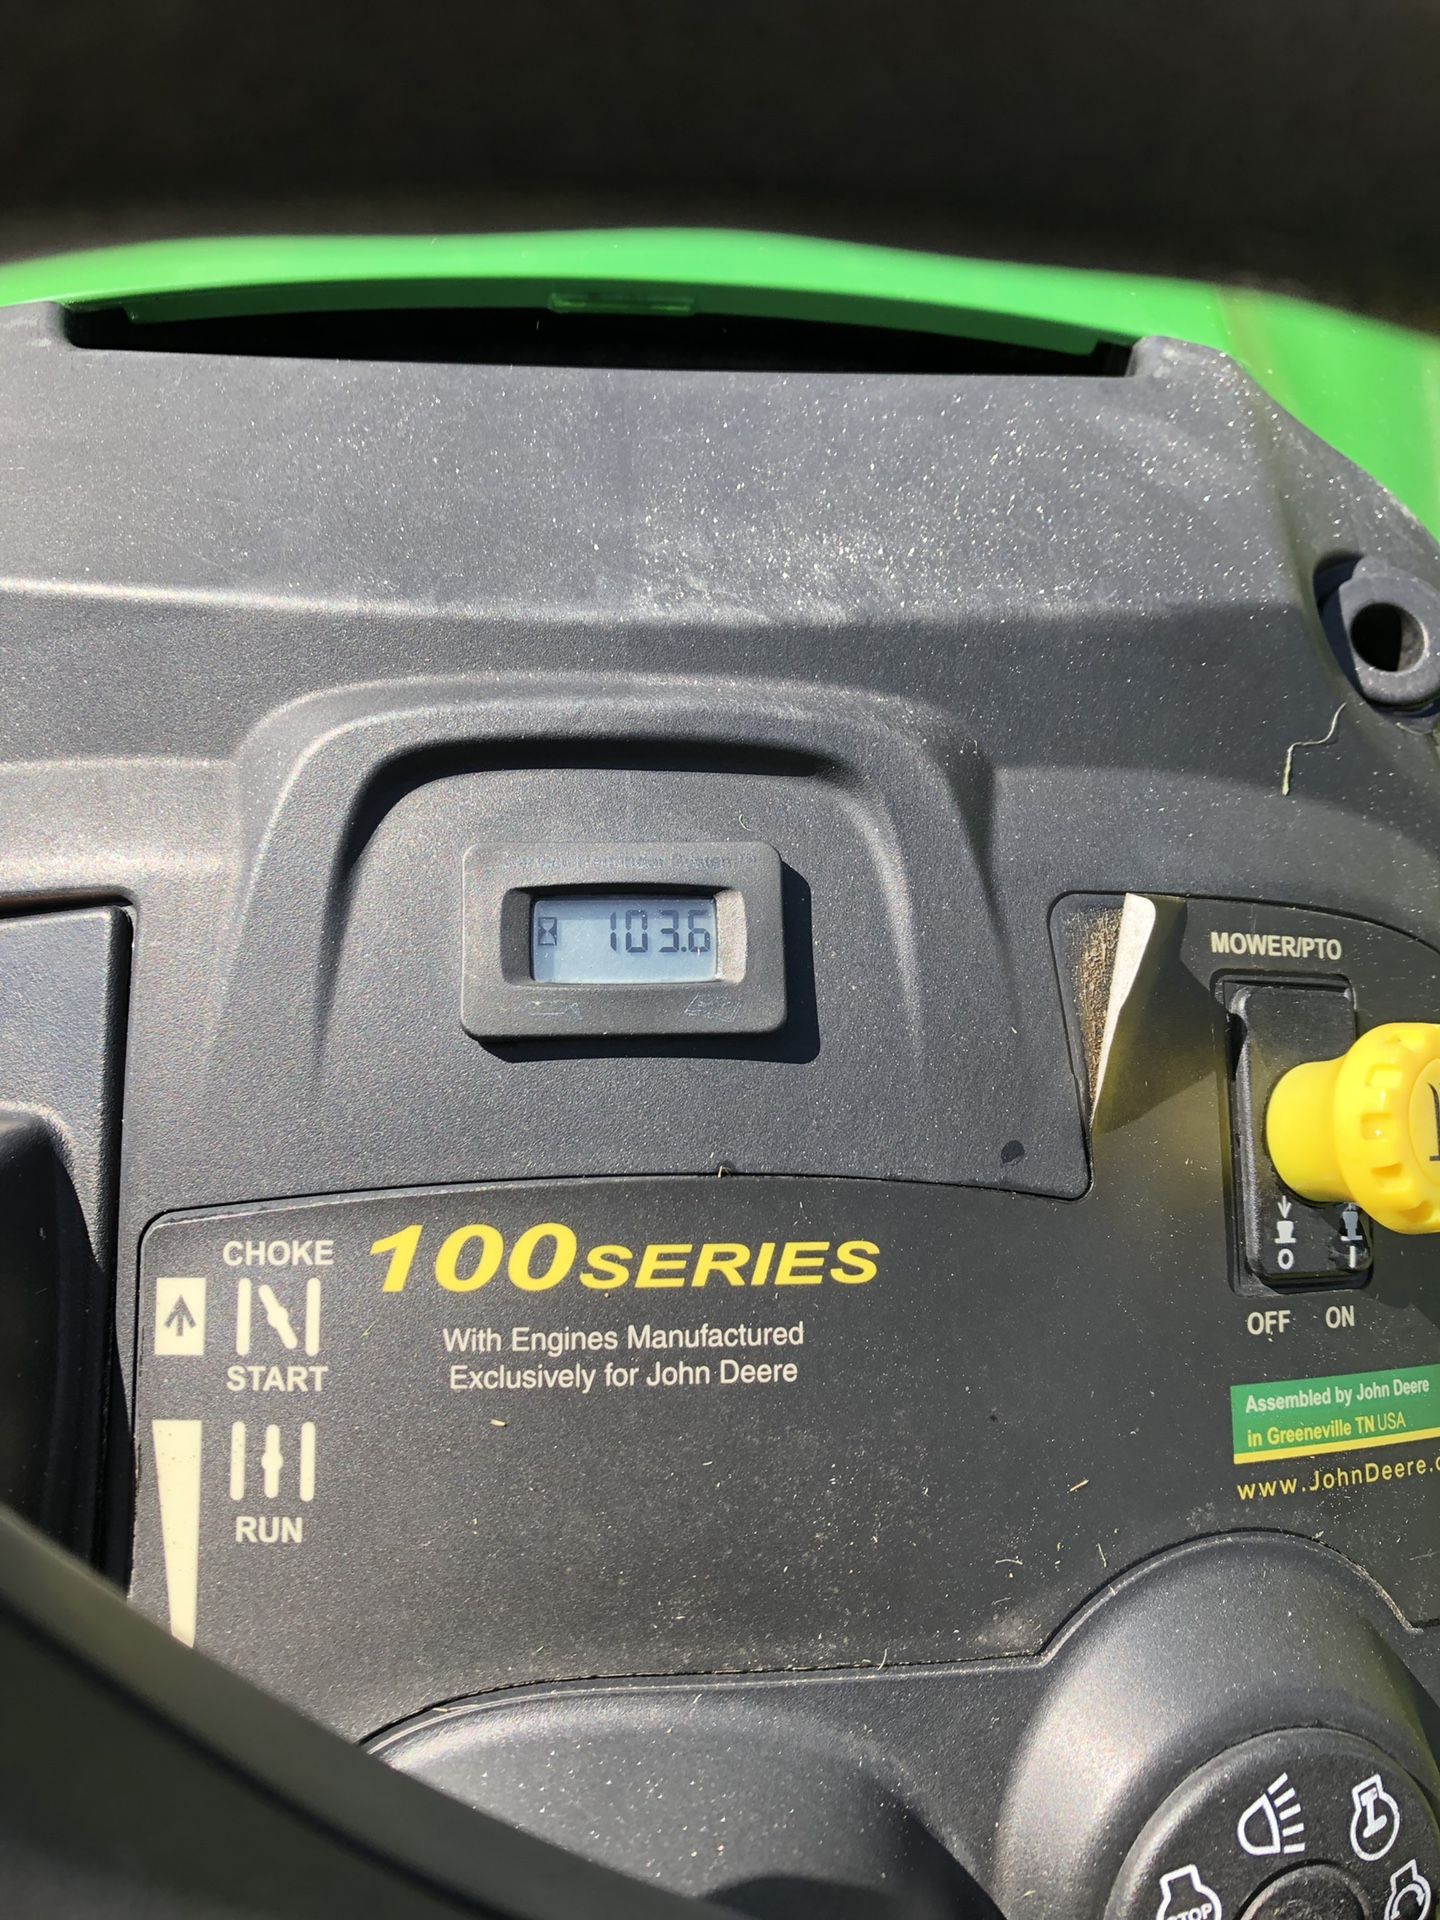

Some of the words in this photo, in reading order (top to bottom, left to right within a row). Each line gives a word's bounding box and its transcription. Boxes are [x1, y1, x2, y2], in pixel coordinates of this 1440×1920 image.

[609, 909, 711, 953] 103.6
[1210, 931, 1342, 961] MOWER/PTO
[222, 1239, 335, 1267] CHOKE
[371, 1222, 578, 1293] 100
[579, 1240, 881, 1291] SERIES
[1247, 1310, 1291, 1335] OFF
[1325, 1305, 1355, 1329] ON
[442, 1327, 502, 1354] With
[509, 1326, 619, 1358] Engines
[627, 1320, 805, 1350] Manufactured
[226, 1364, 329, 1392] START
[449, 1362, 597, 1394] Exclusively
[603, 1361, 640, 1388] for
[646, 1360, 710, 1387] John
[719, 1359, 798, 1384] Deere
[1245, 1386, 1331, 1413] Assembled
[1335, 1385, 1353, 1407] by
[1356, 1381, 1390, 1401] John
[1393, 1378, 1430, 1396] Deere
[1247, 1429, 1263, 1447] in
[1267, 1418, 1352, 1446] Greeneville
[1354, 1415, 1375, 1434] TN
[1377, 1411, 1407, 1431] USA
[235, 1515, 303, 1544] RUN
